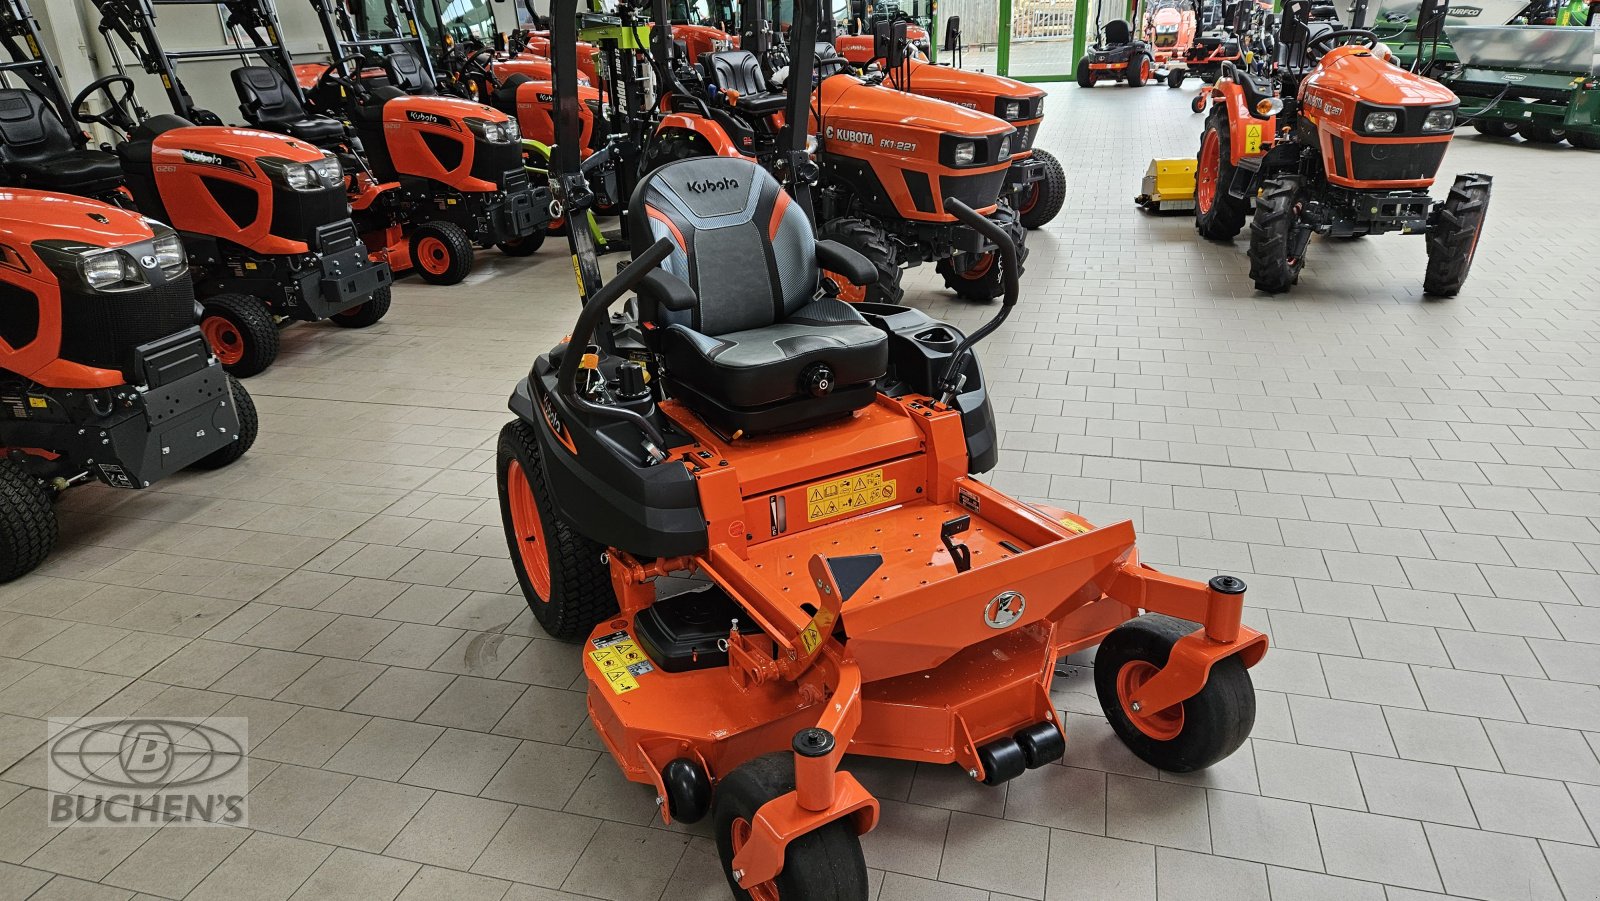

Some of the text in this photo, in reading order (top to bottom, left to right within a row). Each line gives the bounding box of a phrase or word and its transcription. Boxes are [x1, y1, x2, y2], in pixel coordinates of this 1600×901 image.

[1447, 7, 1480, 16] TURFCO
[616, 79, 628, 115] Paldu
[410, 111, 438, 123] Kubota
[836, 128, 917, 152] KUBOTA EK1-221
[188, 151, 222, 165] Kubota
[155, 165, 177, 173] G261
[686, 177, 740, 193] Kubota
